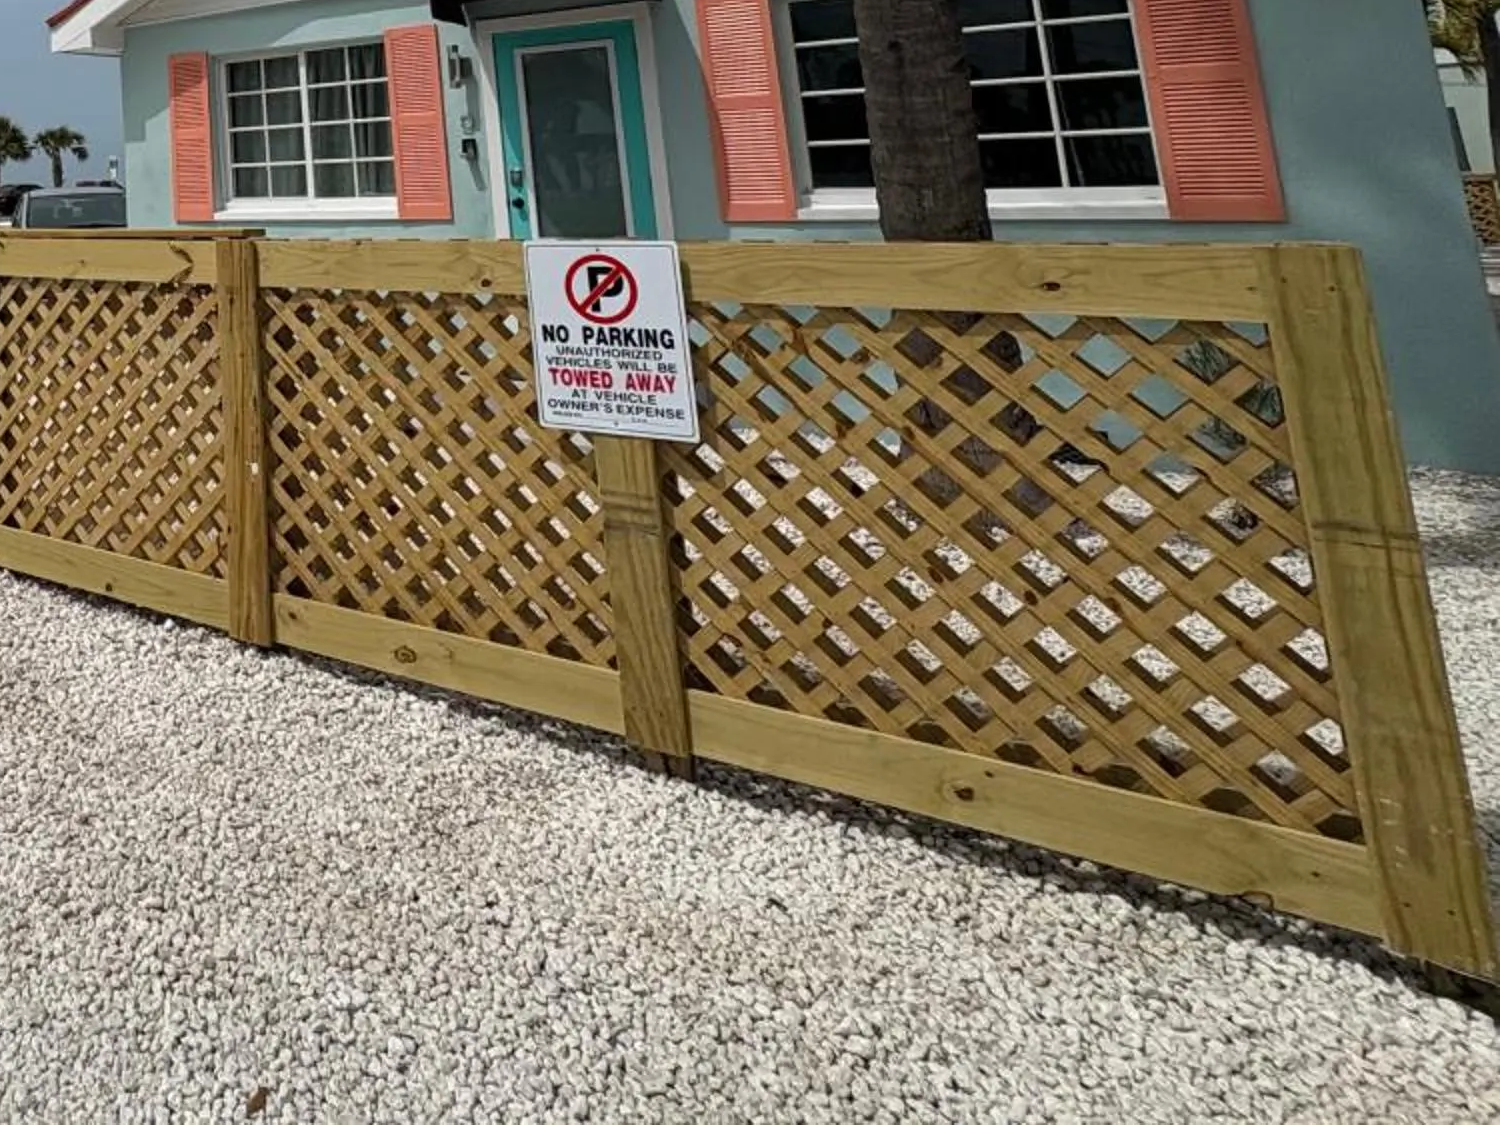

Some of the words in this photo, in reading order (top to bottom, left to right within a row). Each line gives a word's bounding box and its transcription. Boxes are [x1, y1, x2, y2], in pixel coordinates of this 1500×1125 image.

[541, 324, 570, 343] NO
[582, 326, 675, 350] PARKING
[555, 345, 663, 361] UNAUTHORIZED
[545, 355, 613, 370] VEHICLES
[616, 360, 653, 373] WILL
[657, 363, 678, 374] BE
[548, 368, 613, 389] TOWED
[625, 372, 676, 394] AWAY
[571, 389, 589, 399] AT
[594, 391, 658, 406] VEHICLE
[547, 398, 613, 414] OWNER'S
[616, 404, 686, 420] EXPENSE
